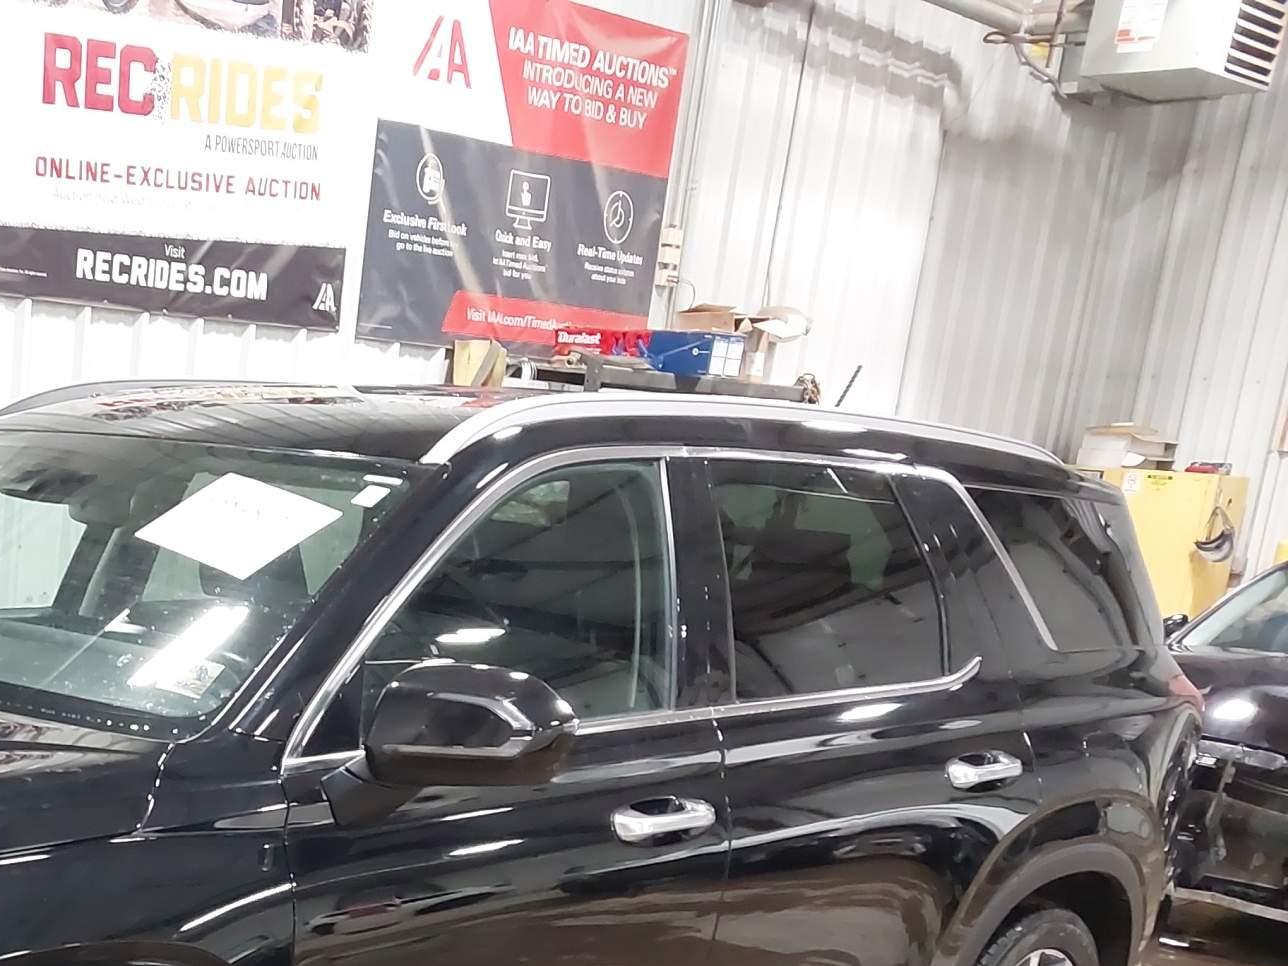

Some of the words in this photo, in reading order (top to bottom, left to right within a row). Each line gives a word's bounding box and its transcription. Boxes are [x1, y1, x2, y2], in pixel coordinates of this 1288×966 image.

[509, 27, 534, 57] IAA
[537, 35, 591, 69] TIMED
[523, 59, 613, 99] INTRODUCING
[615, 84, 624, 103] A
[627, 86, 658, 109] NEW
[528, 87, 560, 112] WAY
[563, 92, 583, 115] TO
[584, 98, 604, 121] BID
[605, 104, 617, 124] &
[619, 107, 647, 129] BUY
[205, 134, 212, 151] A
[215, 135, 281, 157] POWERSPORT
[281, 141, 319, 161] AUCTION
[35, 156, 235, 194] ONLINE-EXCLUSIVE
[245, 176, 321, 201] AUCTION
[383, 209, 427, 229] Exclusive
[164, 243, 186, 259] Visit
[495, 229, 514, 245] Quick
[515, 235, 531, 248] and
[532, 235, 552, 252] Easy
[577, 243, 616, 261] Real-Time
[76, 248, 268, 300] RECRIDES.COM
[466, 306, 486, 321] Visit
[557, 331, 601, 345] Duralast
